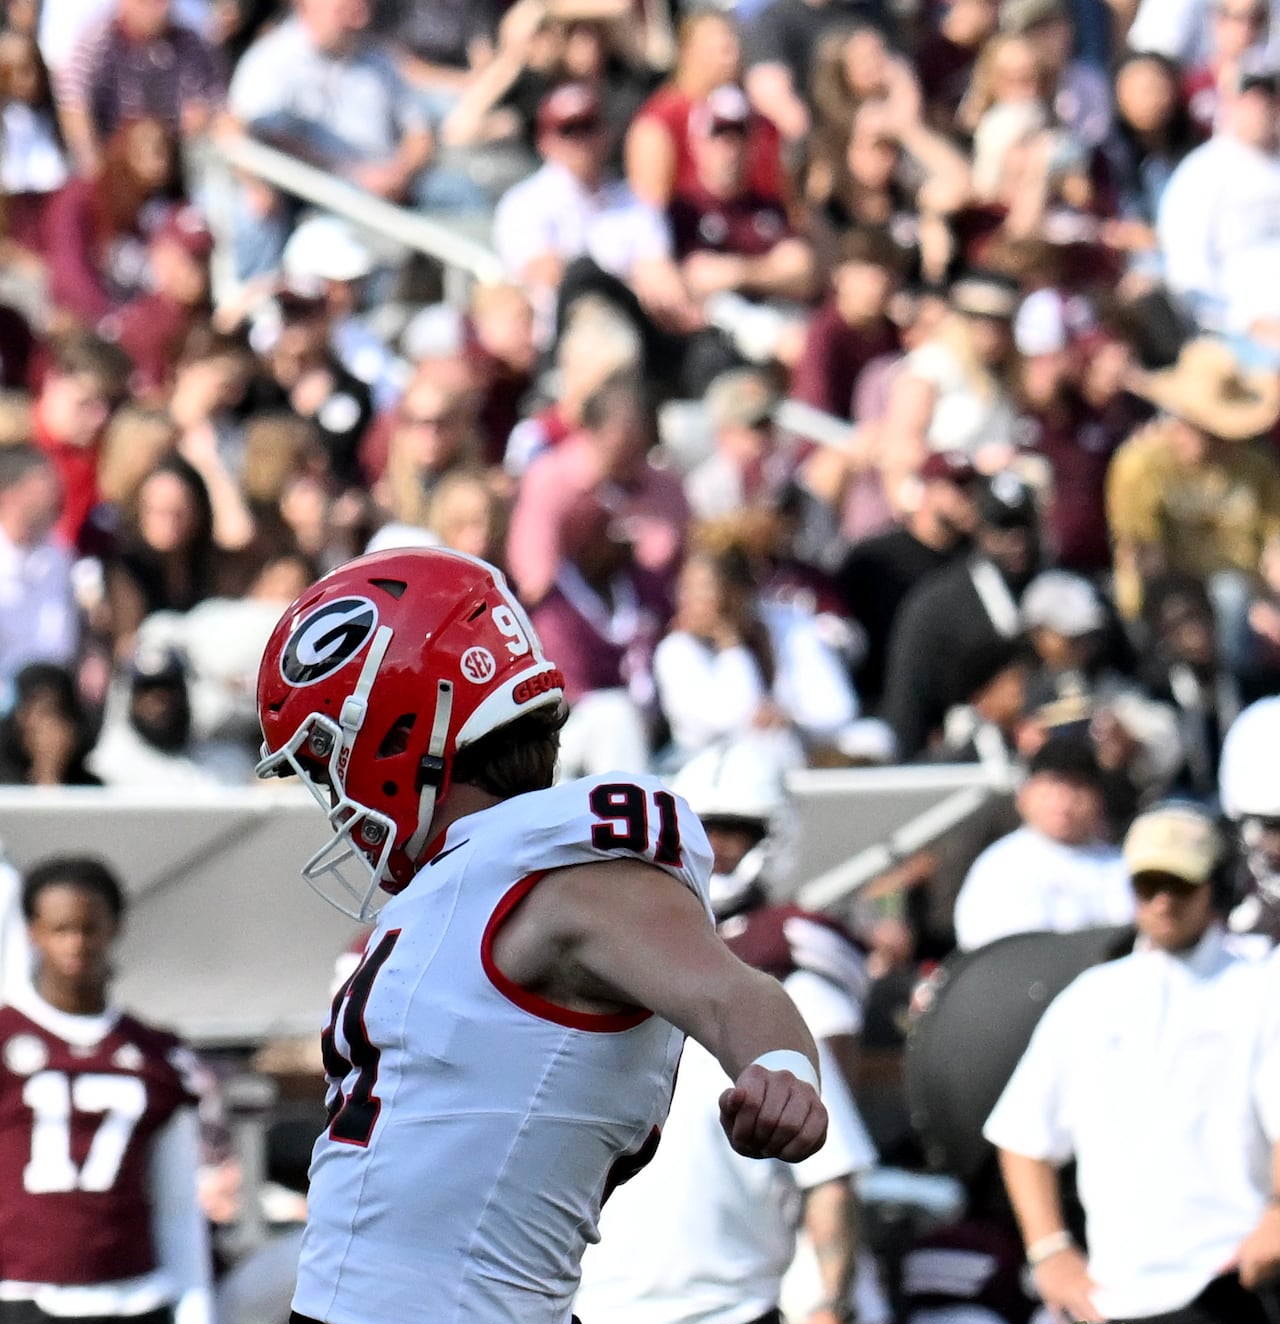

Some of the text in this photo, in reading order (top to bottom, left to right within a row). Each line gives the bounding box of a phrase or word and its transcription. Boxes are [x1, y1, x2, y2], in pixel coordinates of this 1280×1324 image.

[463, 649, 492, 680] SEC
[589, 783, 683, 868] 91
[22, 1069, 149, 1195] 17
